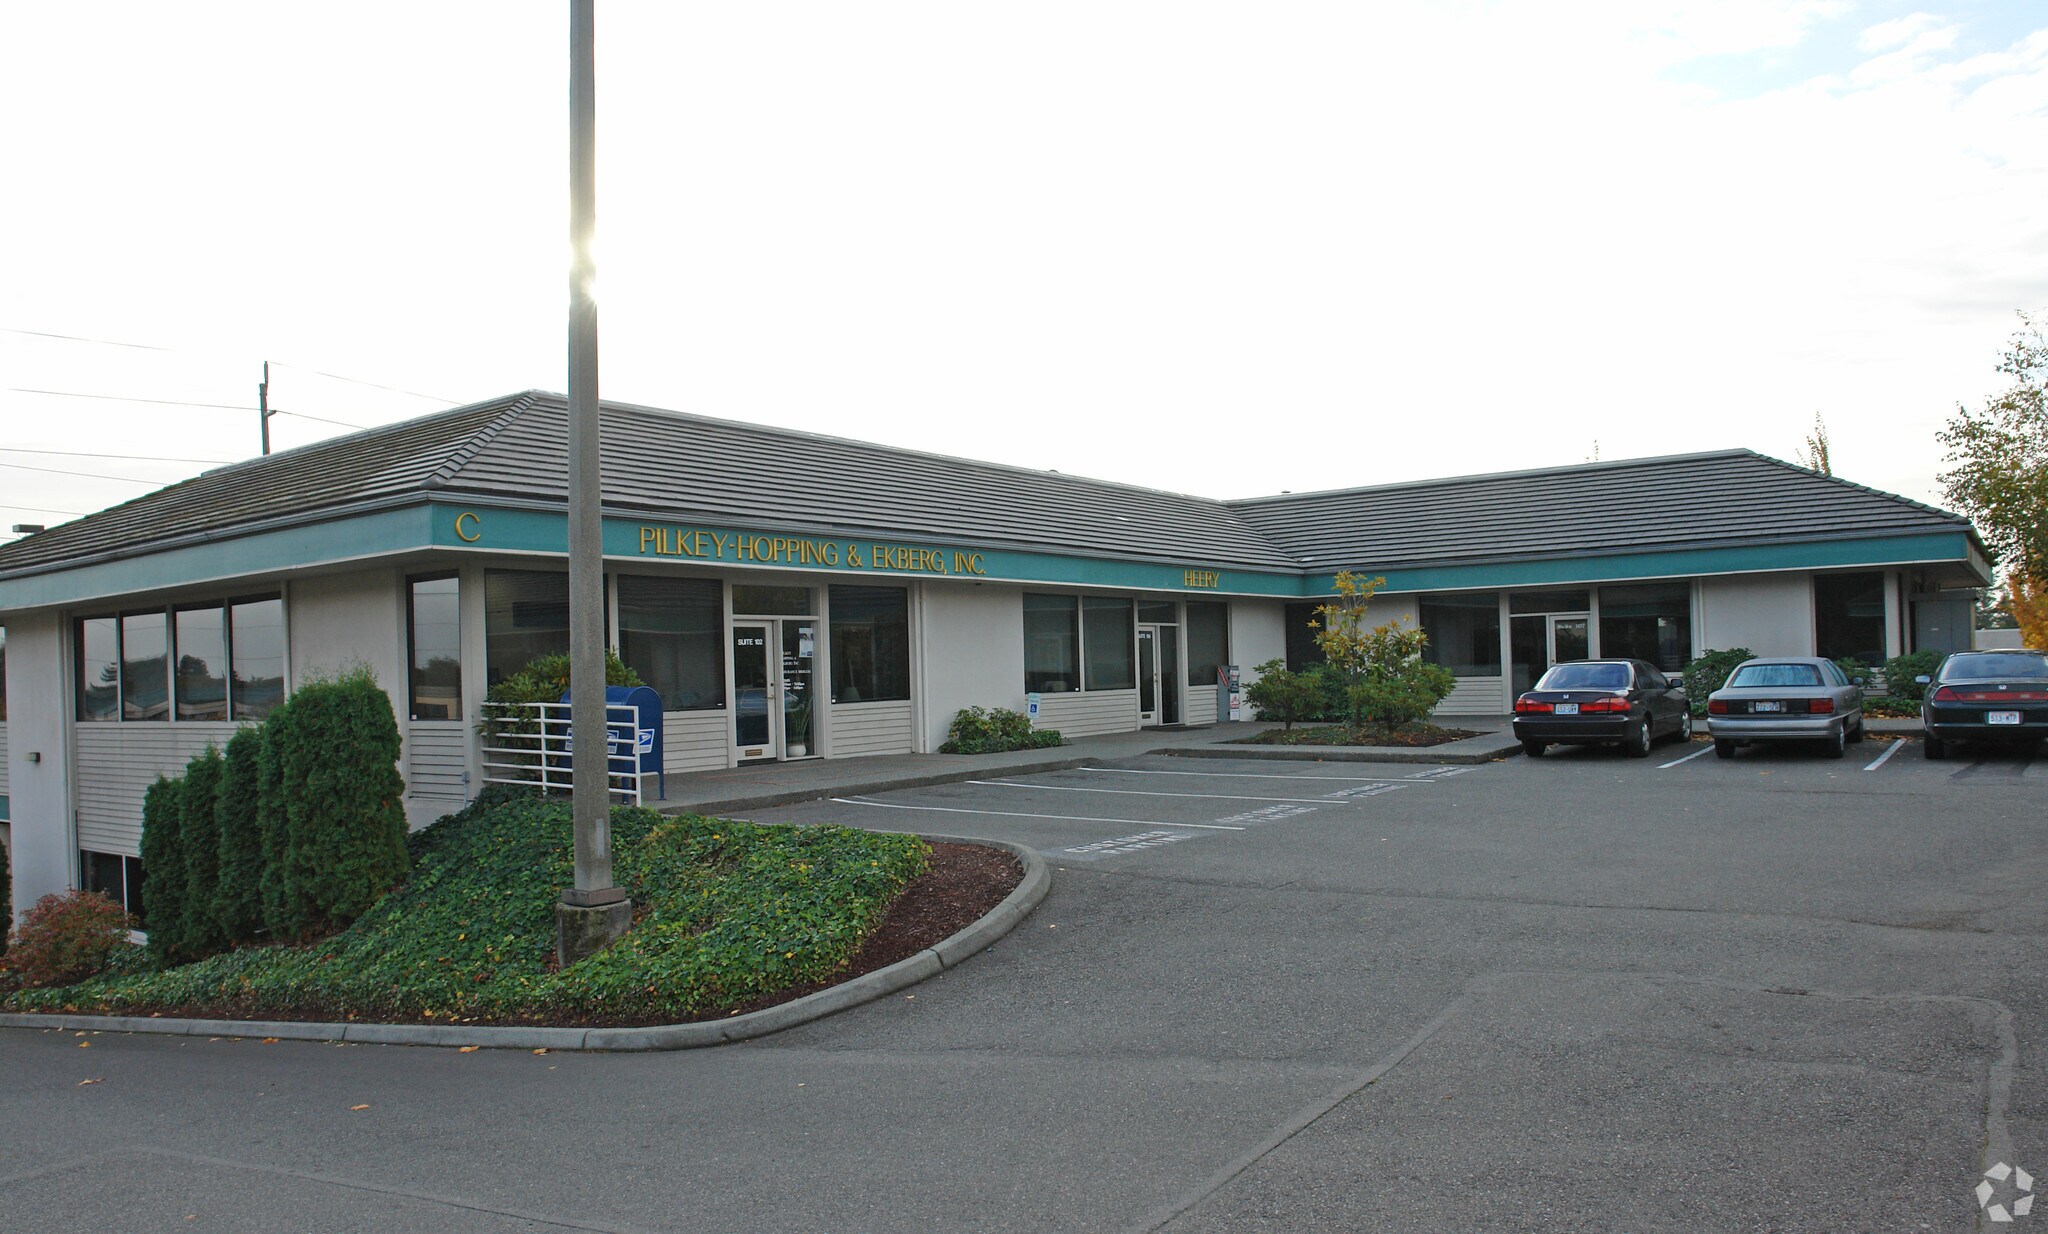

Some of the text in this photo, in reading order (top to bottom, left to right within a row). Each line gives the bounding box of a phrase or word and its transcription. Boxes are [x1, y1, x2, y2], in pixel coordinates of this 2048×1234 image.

[455, 513, 480, 542] C
[639, 527, 986, 575] PILKEY-HOPPING & EKBERG, INC.
[1183, 569, 1220, 589] HEERY
[737, 638, 763, 646] SUITE 102
